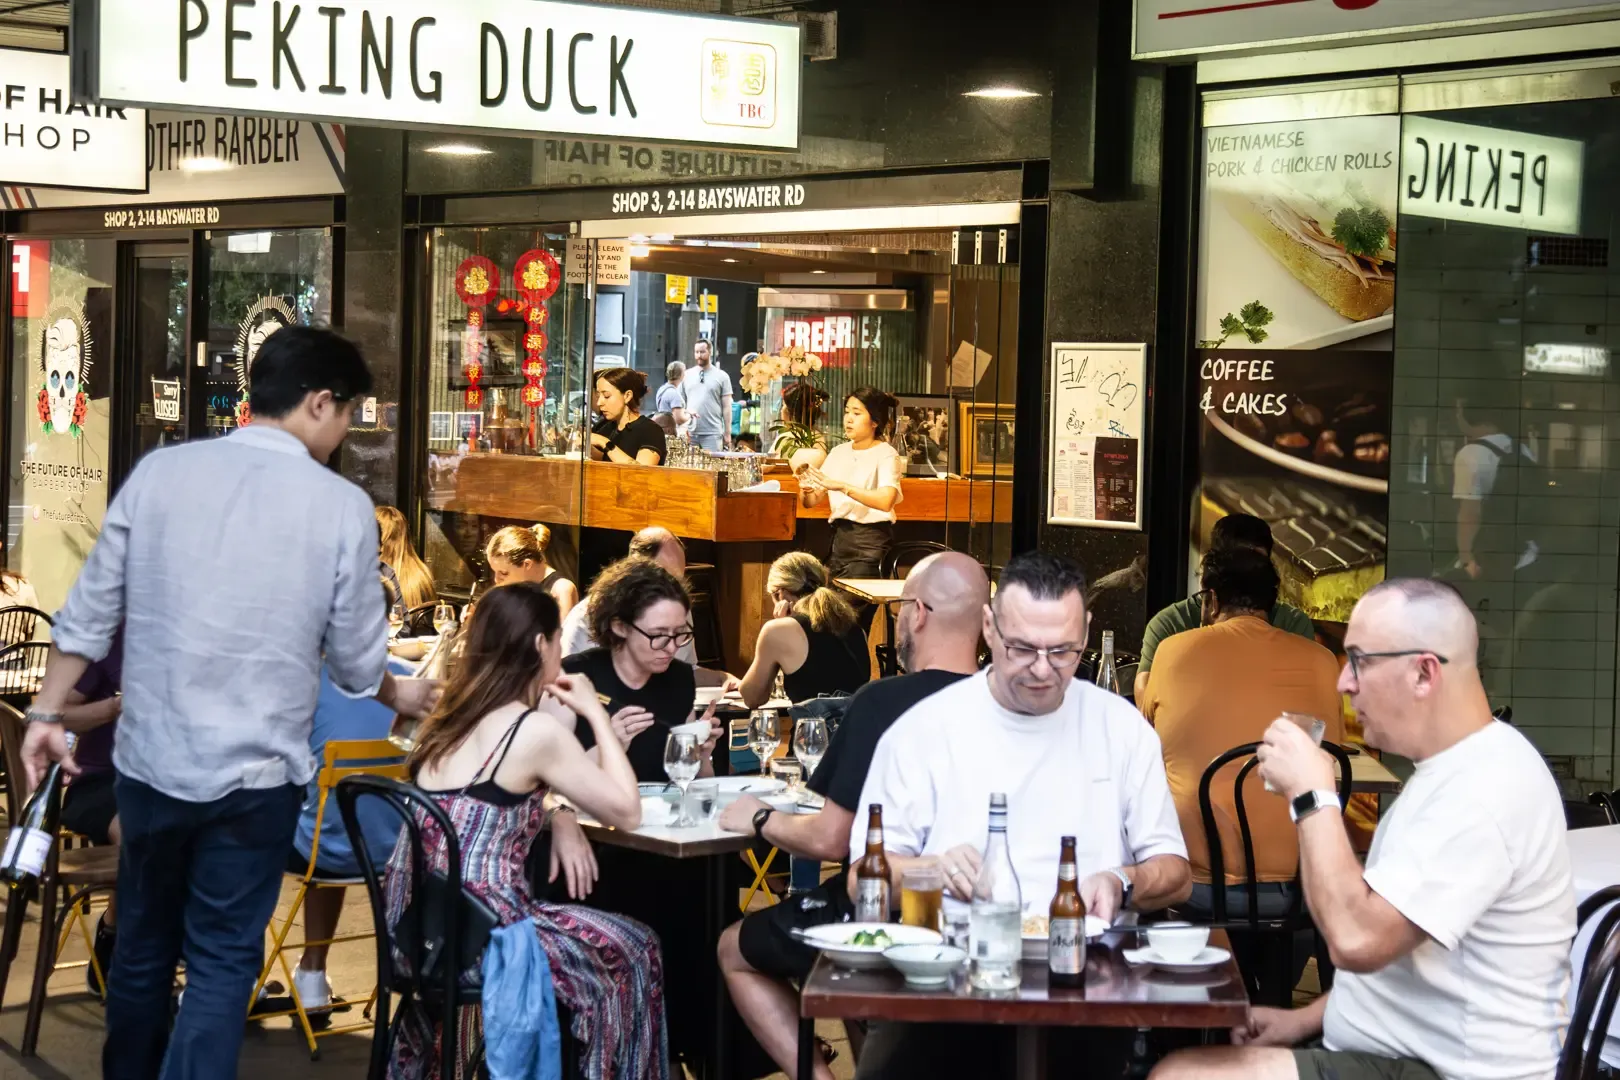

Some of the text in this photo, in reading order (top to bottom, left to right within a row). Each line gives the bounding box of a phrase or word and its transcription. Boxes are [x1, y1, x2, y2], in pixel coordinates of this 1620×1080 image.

[178, 0, 443, 104] PEKING
[480, 21, 638, 119] DUCK
[0, 84, 26, 110] F
[738, 102, 767, 120] TBC
[214, 115, 300, 165] BARBER
[1207, 131, 1305, 153] VIETNAMESE
[1207, 151, 1393, 178] PORK & CHICKEN ROLLS
[612, 184, 805, 215] SHOP 3, 2-14 BAYSWATER RD
[104, 206, 220, 229] SHOP 2, 2-14 BAYSWATER RD
[572, 244, 625, 253] PLEAE LEAVE
[566, 271, 629, 281] FOOTPTH CLEAR
[578, 262, 617, 271] LEAE THE
[1200, 358, 1275, 381] COFFEE
[155, 399, 178, 418] CLOSED
[1199, 385, 1288, 416] & CAKES
[21, 460, 102, 482] THE FUTURE OF HAIR
